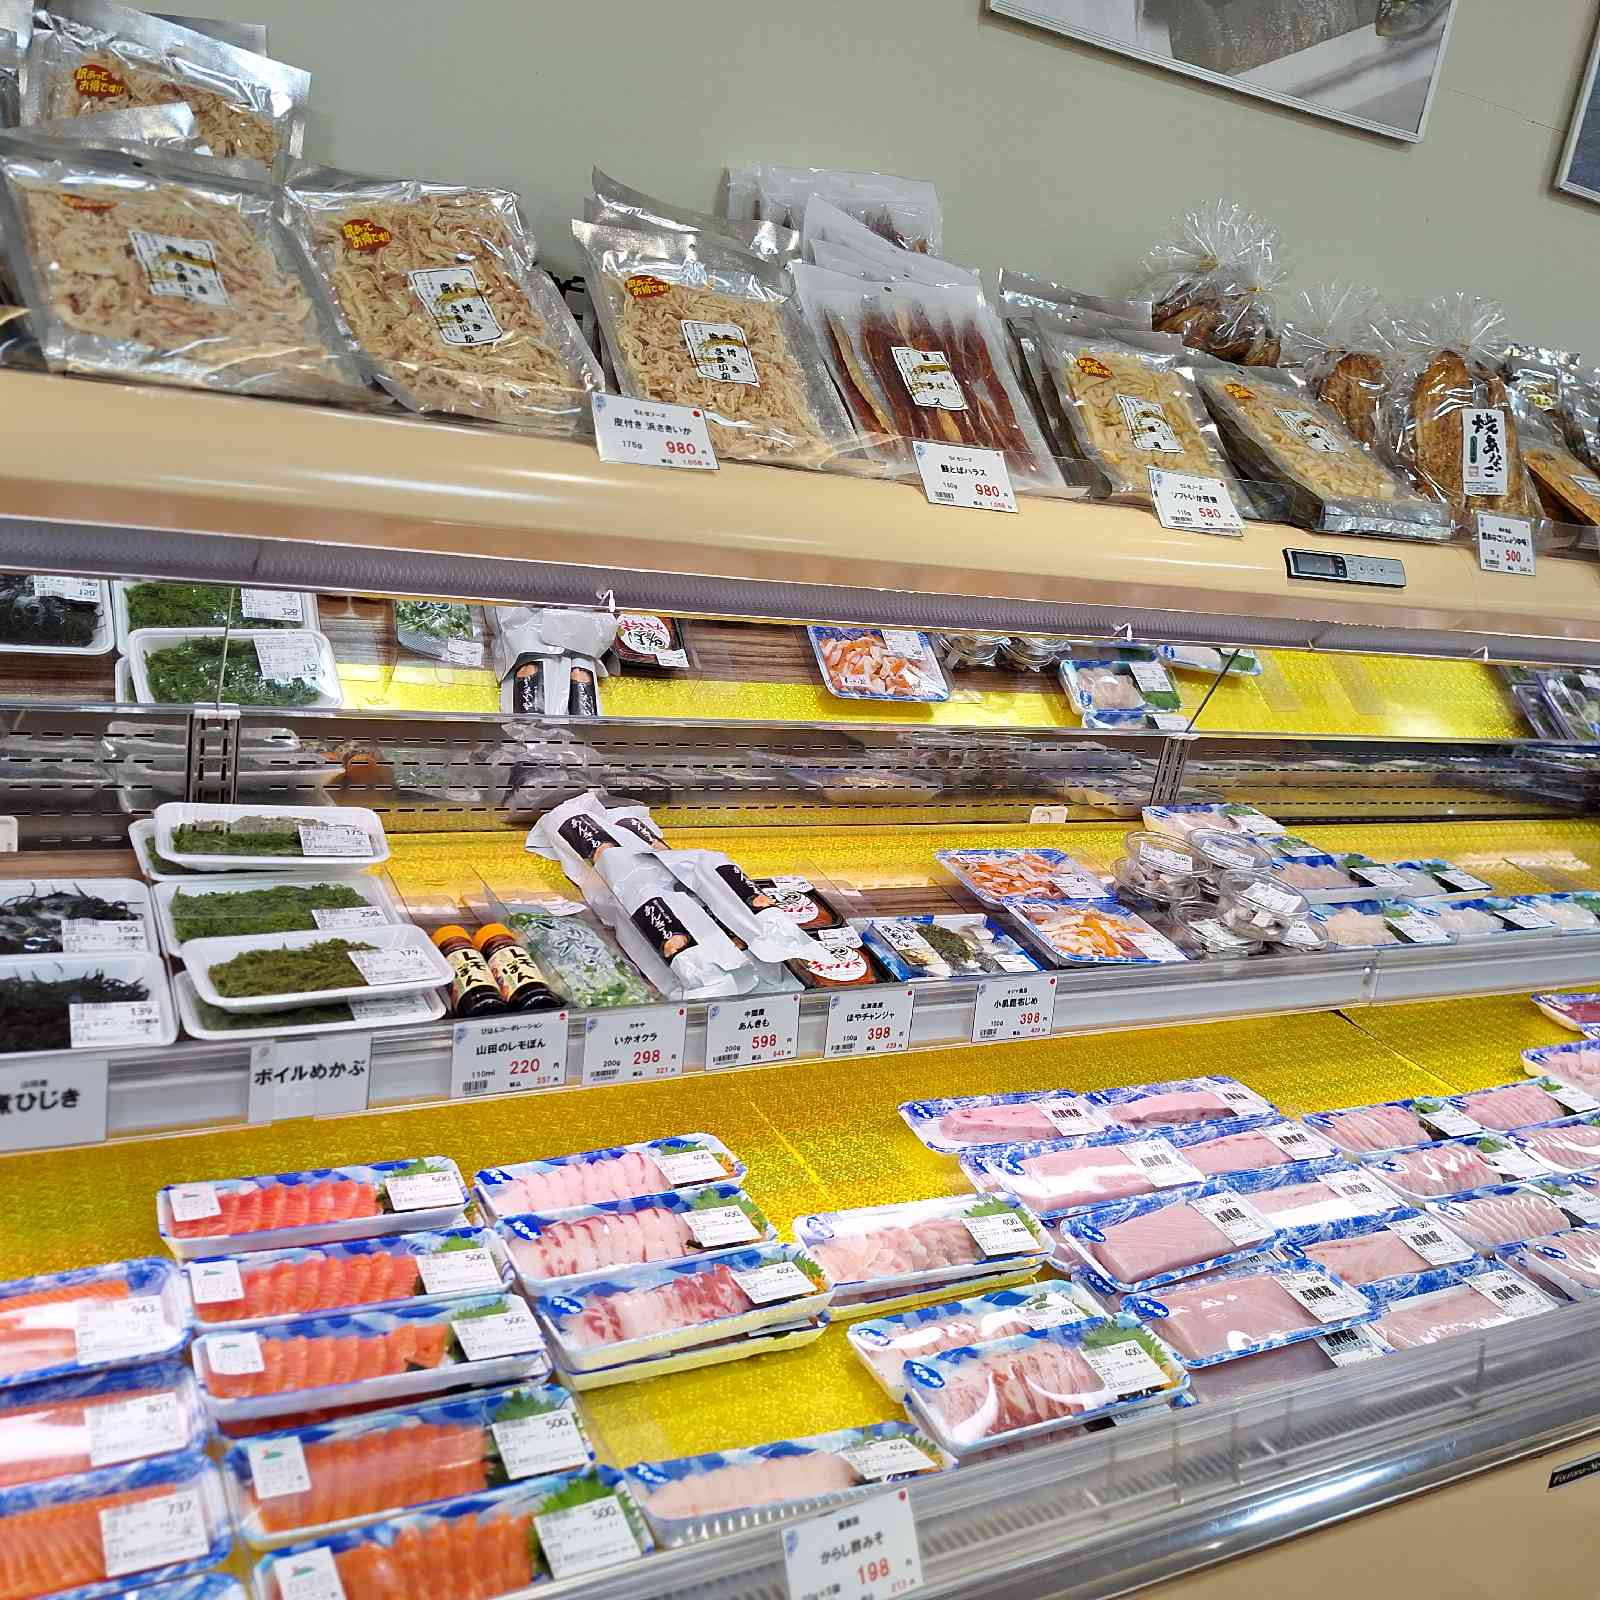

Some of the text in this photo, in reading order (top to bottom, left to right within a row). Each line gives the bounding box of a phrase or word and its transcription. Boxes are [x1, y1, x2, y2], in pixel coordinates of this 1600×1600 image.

[665, 440, 696, 455] 980
[975, 483, 1000, 498] 980
[1198, 507, 1222, 519] 580
[1505, 549, 1521, 562] 500
[846, 1011, 895, 1022] ほやチャンジャ
[1019, 1011, 1041, 1025] 398
[738, 1019, 770, 1031] あんきも
[614, 1032, 658, 1046] いかオクラ
[751, 1033, 777, 1049] 598
[866, 1026, 891, 1041] 398
[632, 1049, 661, 1066] 298
[253, 1059, 366, 1087] ボイルめかぶ
[509, 1058, 541, 1076] 220
[857, 1557, 891, 1585] 198
